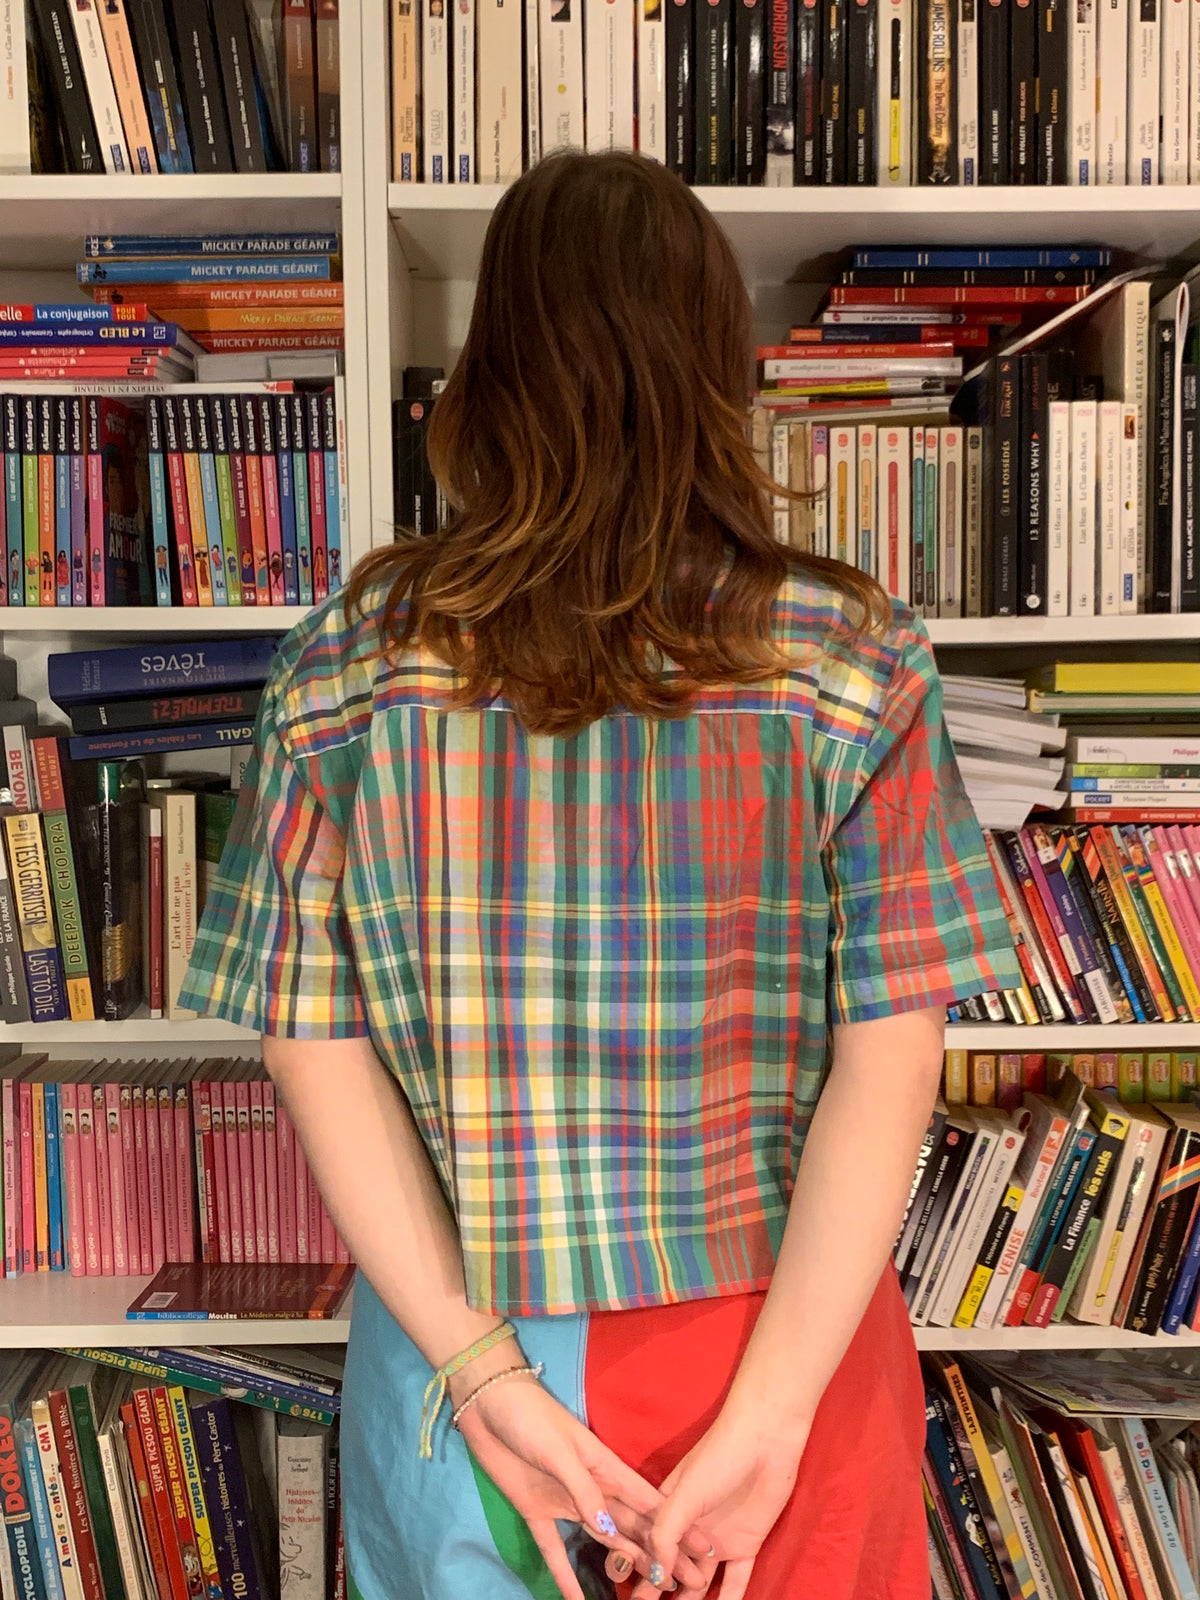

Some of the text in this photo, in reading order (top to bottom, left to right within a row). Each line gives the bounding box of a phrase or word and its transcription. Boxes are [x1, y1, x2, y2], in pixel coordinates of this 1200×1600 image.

[931, 2, 945, 32] JAMES
[50, 11, 66, 54] INCERTAIN
[59, 56, 70, 74] LIEU
[931, 35, 945, 73] ROLLINS
[202, 238, 331, 252] MICKEY PARADE GÉANT
[191, 262, 319, 276] MICKEY PARADE GÉANT
[210, 287, 338, 301] MICKEY PARADE GÉANT
[36, 308, 109, 323] La conjugaison
[99, 327, 146, 339] Le BLED
[213, 334, 340, 348] MICKEY PARADE GÉANT
[1135, 299, 1145, 400] GRÈCE ANTIQUE
[1000, 440, 1010, 504] LES POSSÉDÉS
[1079, 460, 1087, 472] des
[1029, 440, 1040, 541] 13 REASONS WHY
[1054, 474, 1062, 490] Clan
[1079, 473, 1087, 490] Clan
[1079, 492, 1087, 501] Le
[139, 651, 206, 678] rêves
[87, 733, 202, 751] Les fables de La Fontaine
[50, 820, 71, 889] CHOPRA
[16, 842, 48, 927] TESS GERRITSEN
[1, 896, 10, 922] FRANCE
[171, 876, 182, 950] L'art de ne pas
[183, 862, 194, 960] 'empoisonner la vie
[60, 898, 82, 965] DEEPAK
[29, 952, 54, 1016] LAST TO DIE
[1091, 977, 1111, 1015] LAROUSSE
[1062, 1148, 1113, 1251] La Finance les nuls
[995, 1229, 1003, 1238] de
[996, 1164, 1049, 1277] VENISE Routard
[998, 1210, 1011, 1230] France
[240, 1311, 248, 1319] Le
[249, 1311, 274, 1319] Médecin
[83, 1347, 168, 1378] SUPER PICSOU
[950, 1373, 979, 1435] LABYRINTHES
[207, 1411, 218, 1441] Castor
[136, 1394, 164, 1493] SUPER PICSOU GÉANT
[155, 1397, 186, 1520] SUPER PICSOU GÉANT
[174, 1397, 205, 1520] SUPER PICSOU GÉANT
[212, 1441, 223, 1463] Père
[1131, 1432, 1159, 1485] images
[58, 1404, 90, 1533] Les belles histoires de la Bible
[217, 1471, 231, 1511] histoires
[286, 1488, 316, 1496] Histoires
[327, 1478, 336, 1509] LA TOUR
[297, 1515, 322, 1523] Nicolas
[1157, 1504, 1171, 1529] MOTS
[54, 1523, 69, 1555] mots
[1166, 1532, 1177, 1548] DES
[61, 1558, 73, 1568] A
[231, 1573, 248, 1600] 100
